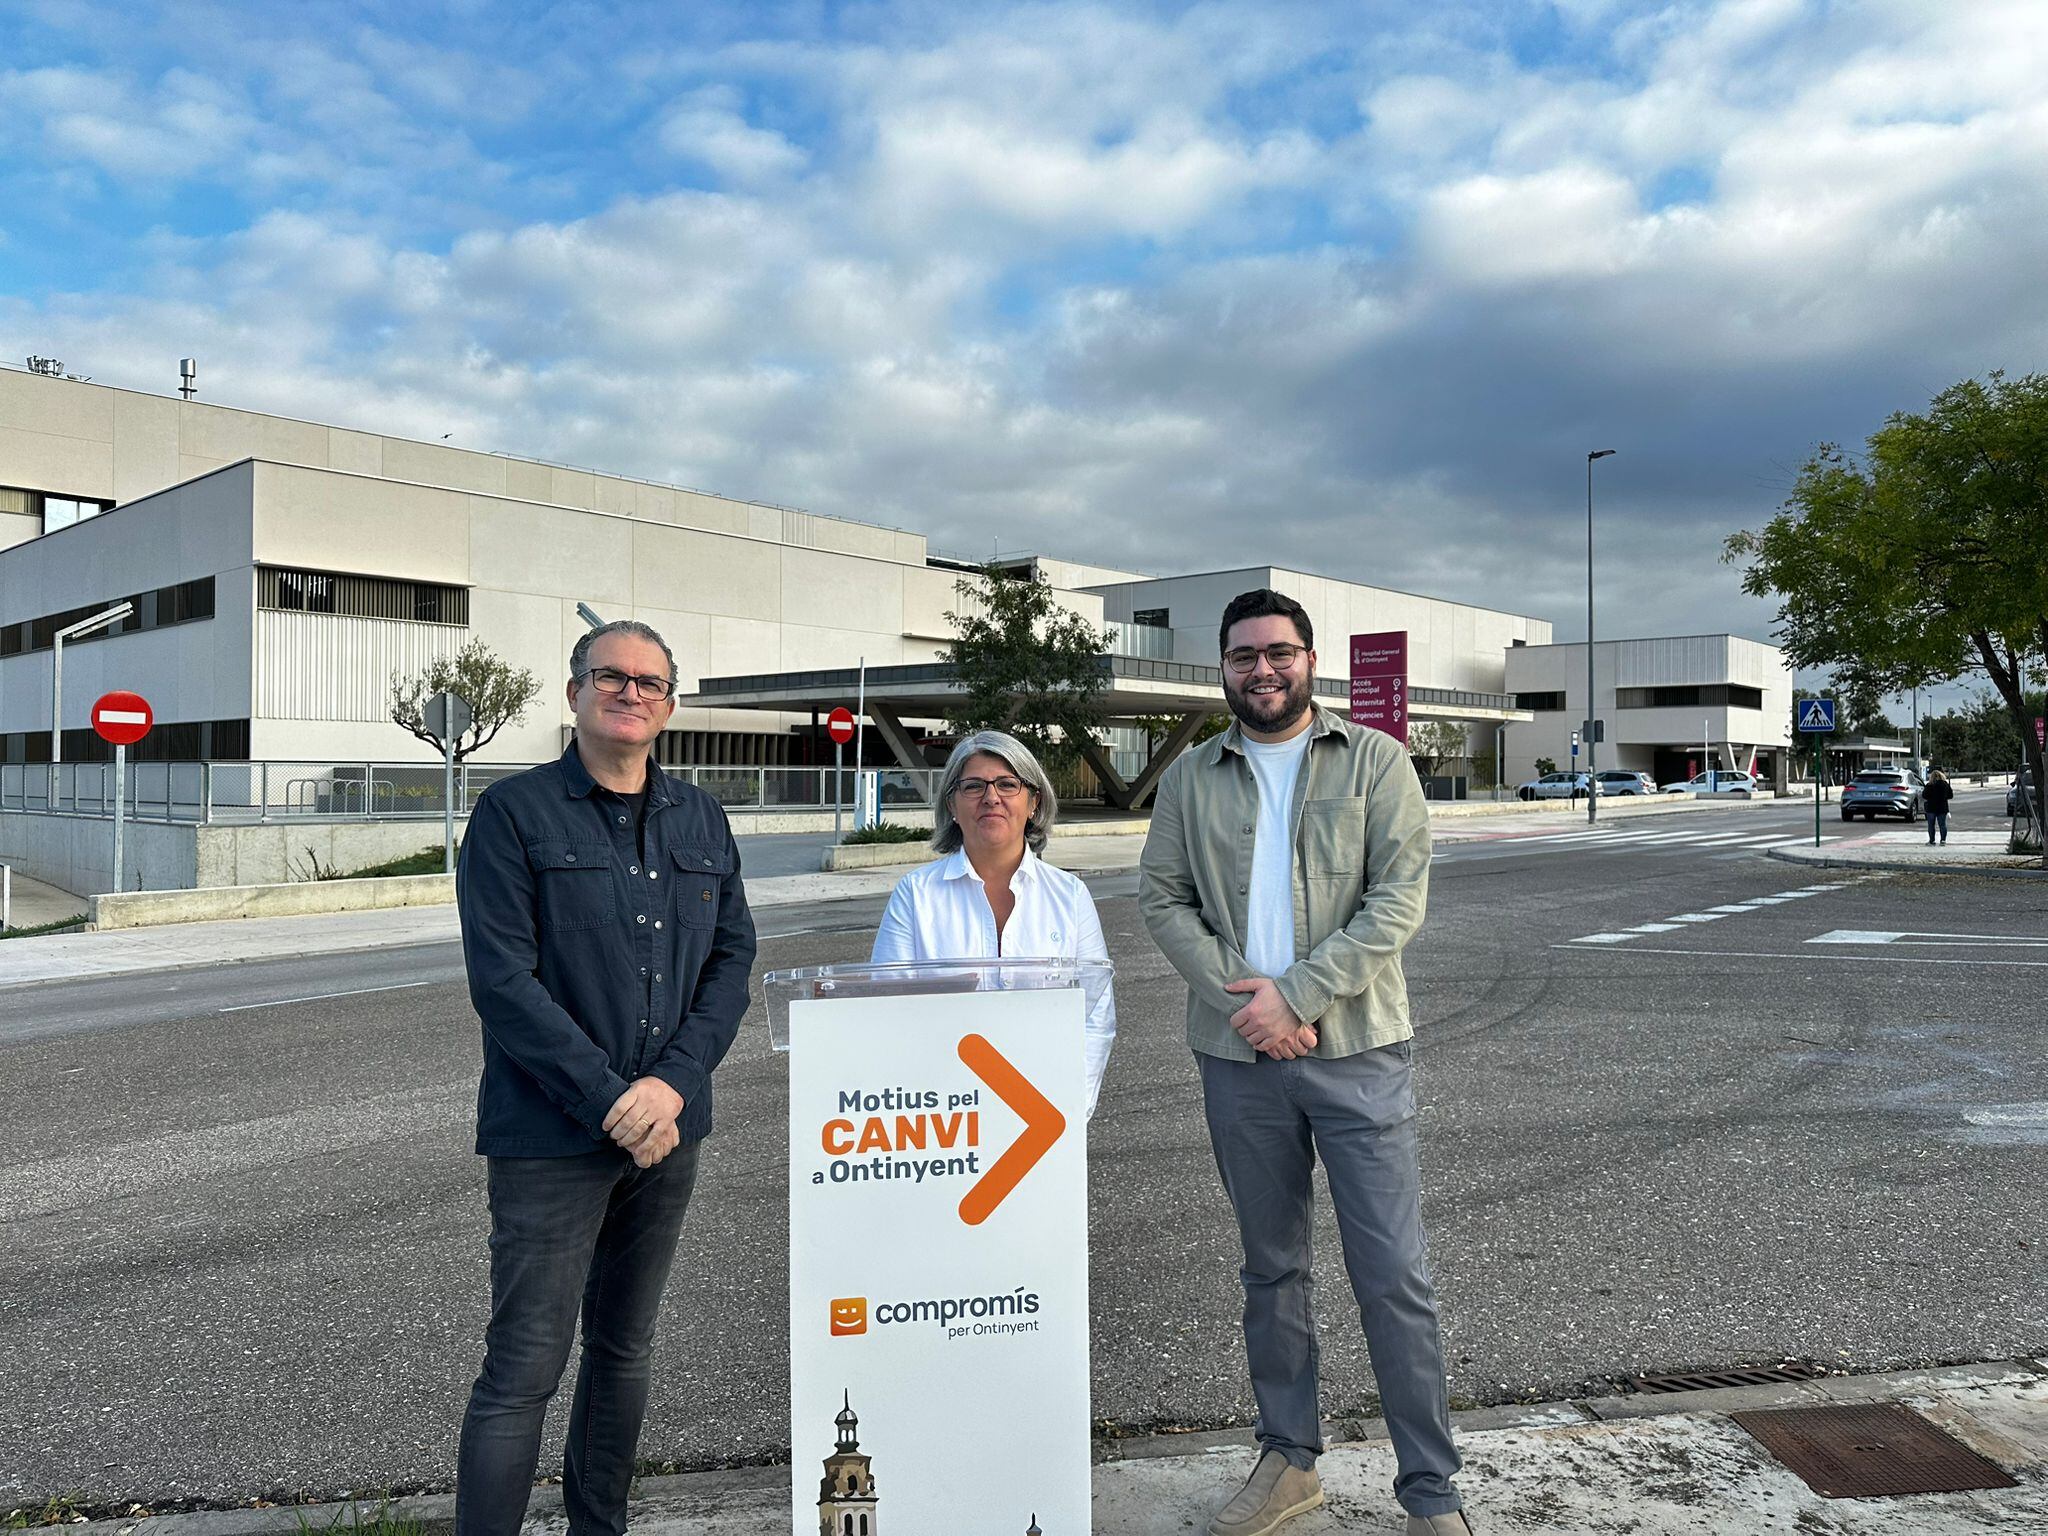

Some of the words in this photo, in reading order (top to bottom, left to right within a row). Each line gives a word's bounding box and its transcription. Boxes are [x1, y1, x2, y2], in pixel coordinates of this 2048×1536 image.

[1353, 686, 1380, 695] principal
[838, 1087, 939, 1113] Motius
[948, 1089, 980, 1110] pel
[821, 1111, 980, 1156] CANVI
[811, 1170, 825, 1184] a
[829, 1151, 980, 1183] Ontinyent
[875, 1286, 1040, 1327] compromís
[948, 1325, 971, 1340] per
[972, 1320, 1040, 1338] Ontinyent
